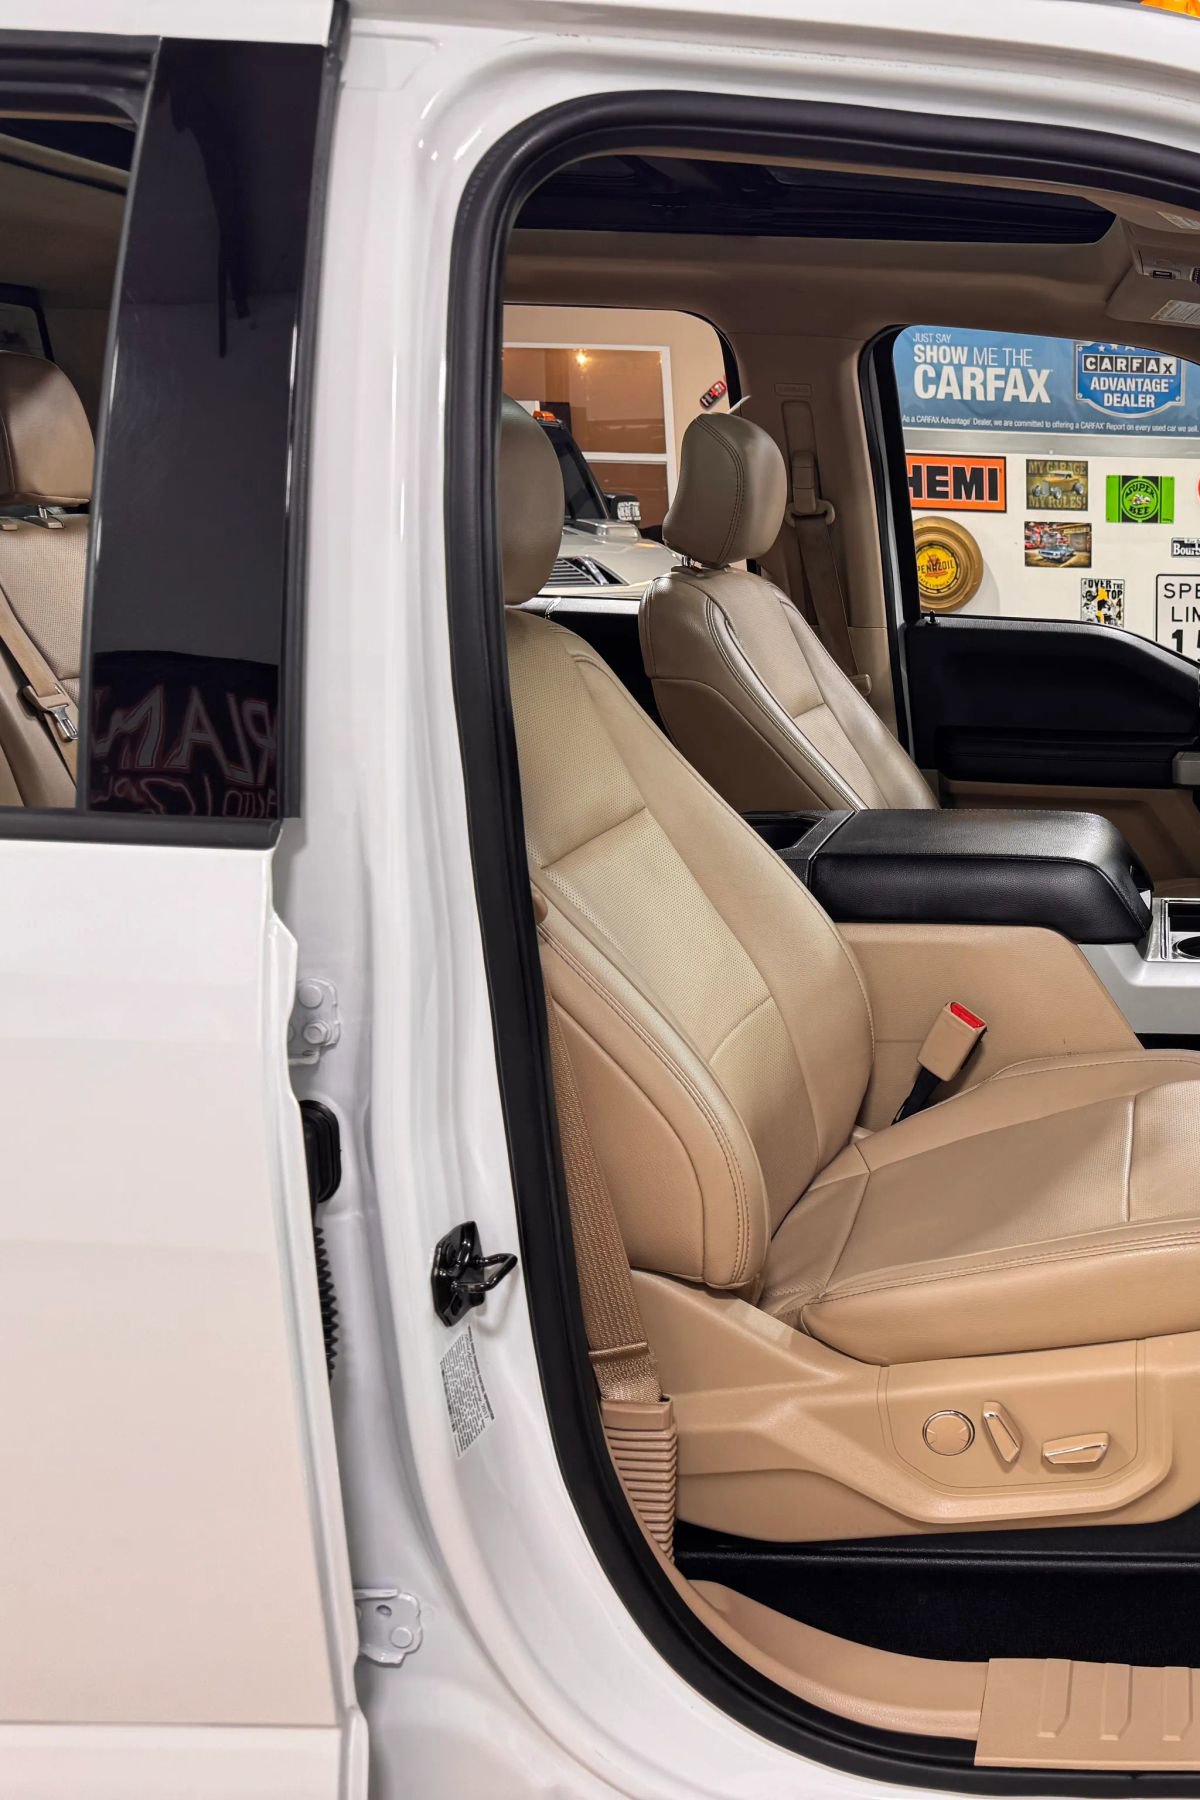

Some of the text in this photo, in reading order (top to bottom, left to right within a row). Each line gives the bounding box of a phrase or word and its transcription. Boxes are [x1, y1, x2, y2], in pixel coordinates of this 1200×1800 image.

[913, 333, 952, 343] JUST SAY
[913, 345, 1033, 367] SHOW ME THE
[1085, 357, 1173, 374] CARFAX
[914, 364, 1051, 403] CARFAX
[1090, 377, 1169, 392] ADVANTAGE
[1104, 393, 1155, 408] DEALER
[916, 416, 940, 424] CARFAX
[1052, 421, 1074, 430] offering
[1080, 421, 1104, 429] CARFAX
[1106, 423, 1125, 431] Report
[1135, 425, 1151, 433] every
[1152, 424, 1166, 432] used
[1028, 461, 1087, 475] MY GARAGE
[906, 465, 999, 501] HEMI
[1126, 483, 1154, 498] SUPER
[1029, 495, 1086, 509] MY RULES!
[1129, 506, 1150, 515] BEE
[1088, 579, 1111, 589] OVER
[1105, 590, 1122, 600] TOP
